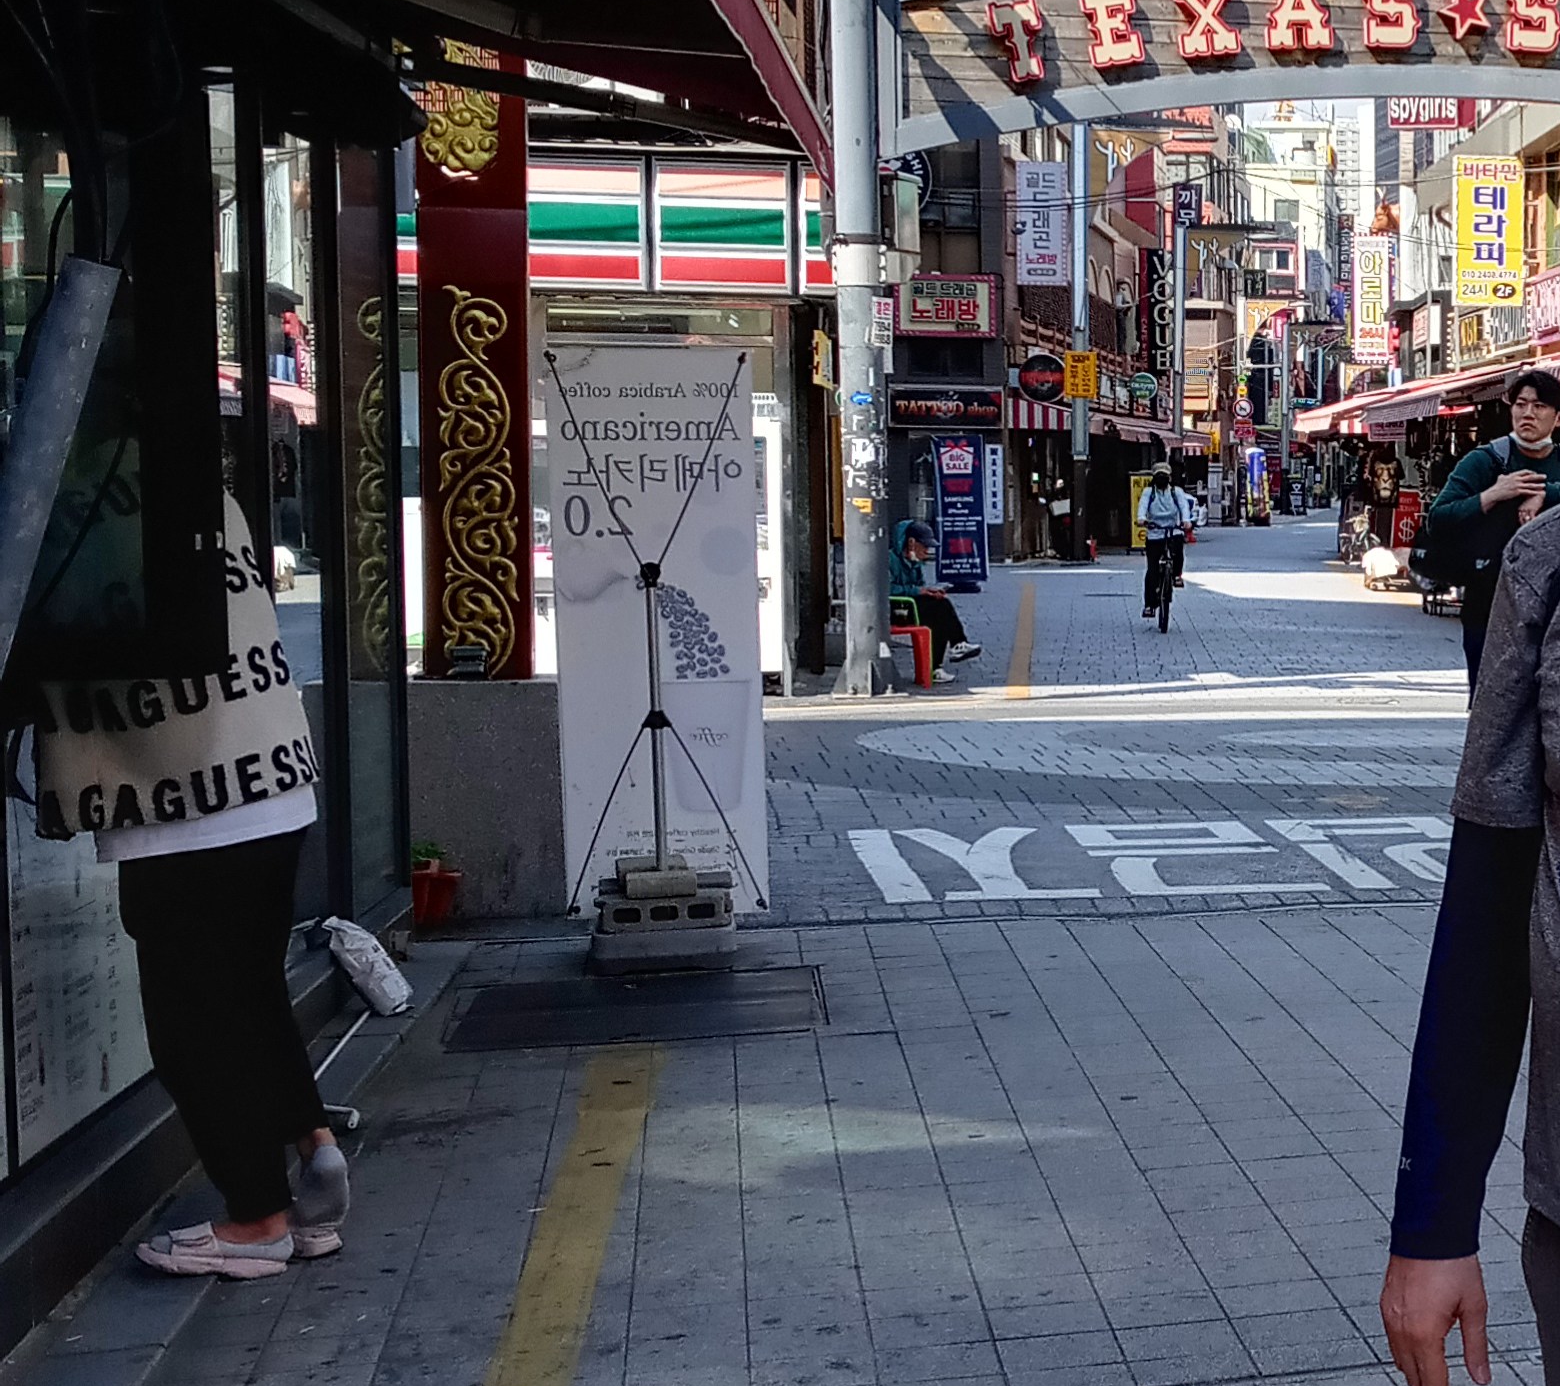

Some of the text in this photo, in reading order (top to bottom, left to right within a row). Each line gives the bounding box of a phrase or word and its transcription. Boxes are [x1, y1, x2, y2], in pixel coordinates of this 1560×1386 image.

[1389, 97, 1457, 126] spygirls
[1473, 186, 1507, 267] 테라피
[1359, 250, 1384, 325] 아로마
[1461, 283, 1488, 296] 24시
[1495, 284, 1513, 297] 2F
[909, 297, 980, 322] 노래방
[1152, 251, 1174, 371] VOGUE
[895, 398, 964, 418] TATTOO
[945, 462, 970, 471] SALE
[949, 451, 966, 462] BIG
[989, 447, 999, 510] WAXING
